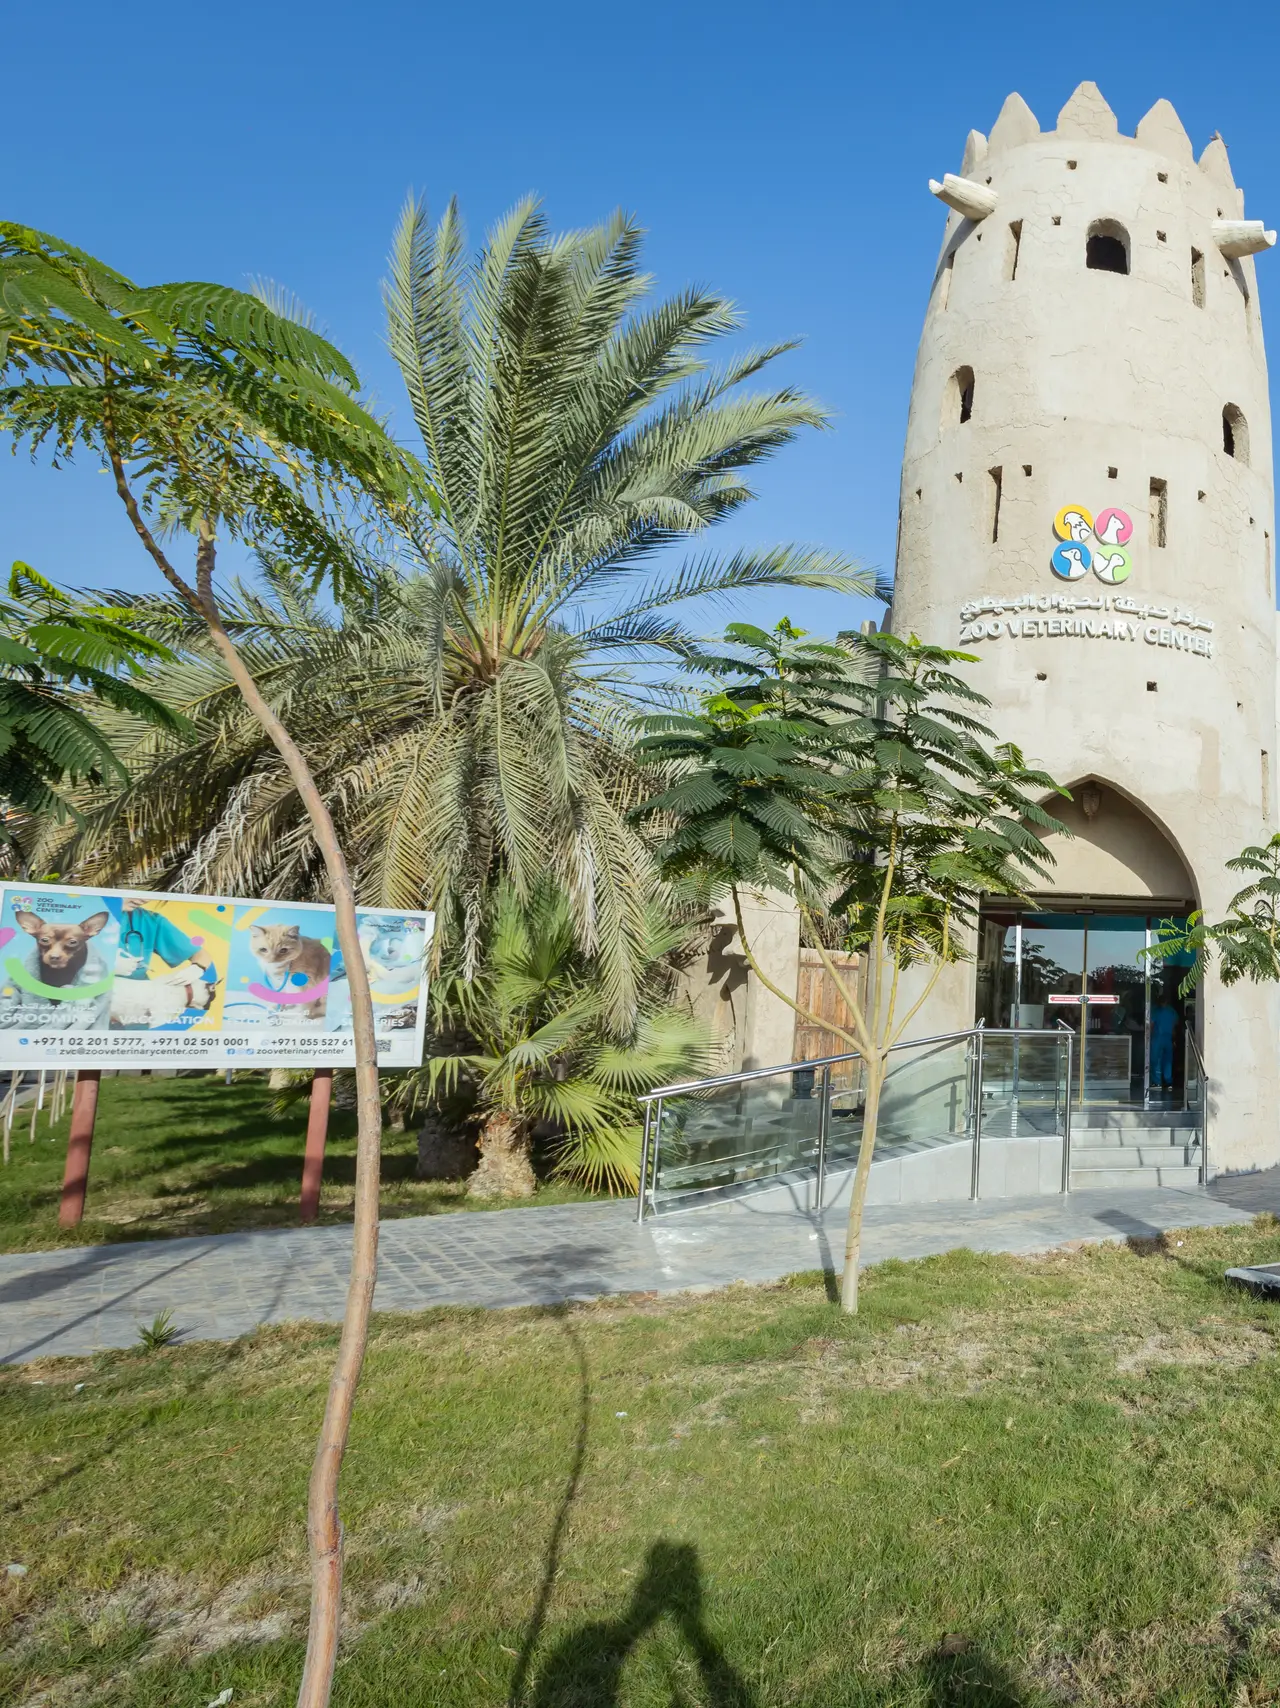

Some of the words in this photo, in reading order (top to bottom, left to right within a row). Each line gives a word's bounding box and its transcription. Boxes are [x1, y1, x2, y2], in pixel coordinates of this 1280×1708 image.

[960, 594, 1036, 620] البيطري
[1037, 593, 1110, 612] الحيوان
[1113, 595, 1170, 619] حديقة
[1171, 606, 1215, 633] مركز
[960, 620, 1004, 643] ZOO
[1006, 617, 1140, 641] VETERINARY
[1144, 626, 1213, 657] CENTER
[1, 1013, 97, 1024] GROOMING
[33, 1037, 64, 1046] +971
[68, 1037, 84, 1046] 02
[87, 1037, 108, 1046] 201
[112, 1037, 145, 1047] 5777,
[151, 1038, 179, 1046] +971
[183, 1038, 197, 1046] 02
[200, 1038, 219, 1046] 501
[223, 1038, 249, 1046] 0001
[271, 1038, 297, 1046] +971
[300, 1038, 318, 1046] 055
[321, 1038, 339, 1046] 527
[59, 1047, 208, 1056] zvc@zooveterinarycenter.com
[256, 1048, 345, 1056] zooveterinarycenter
